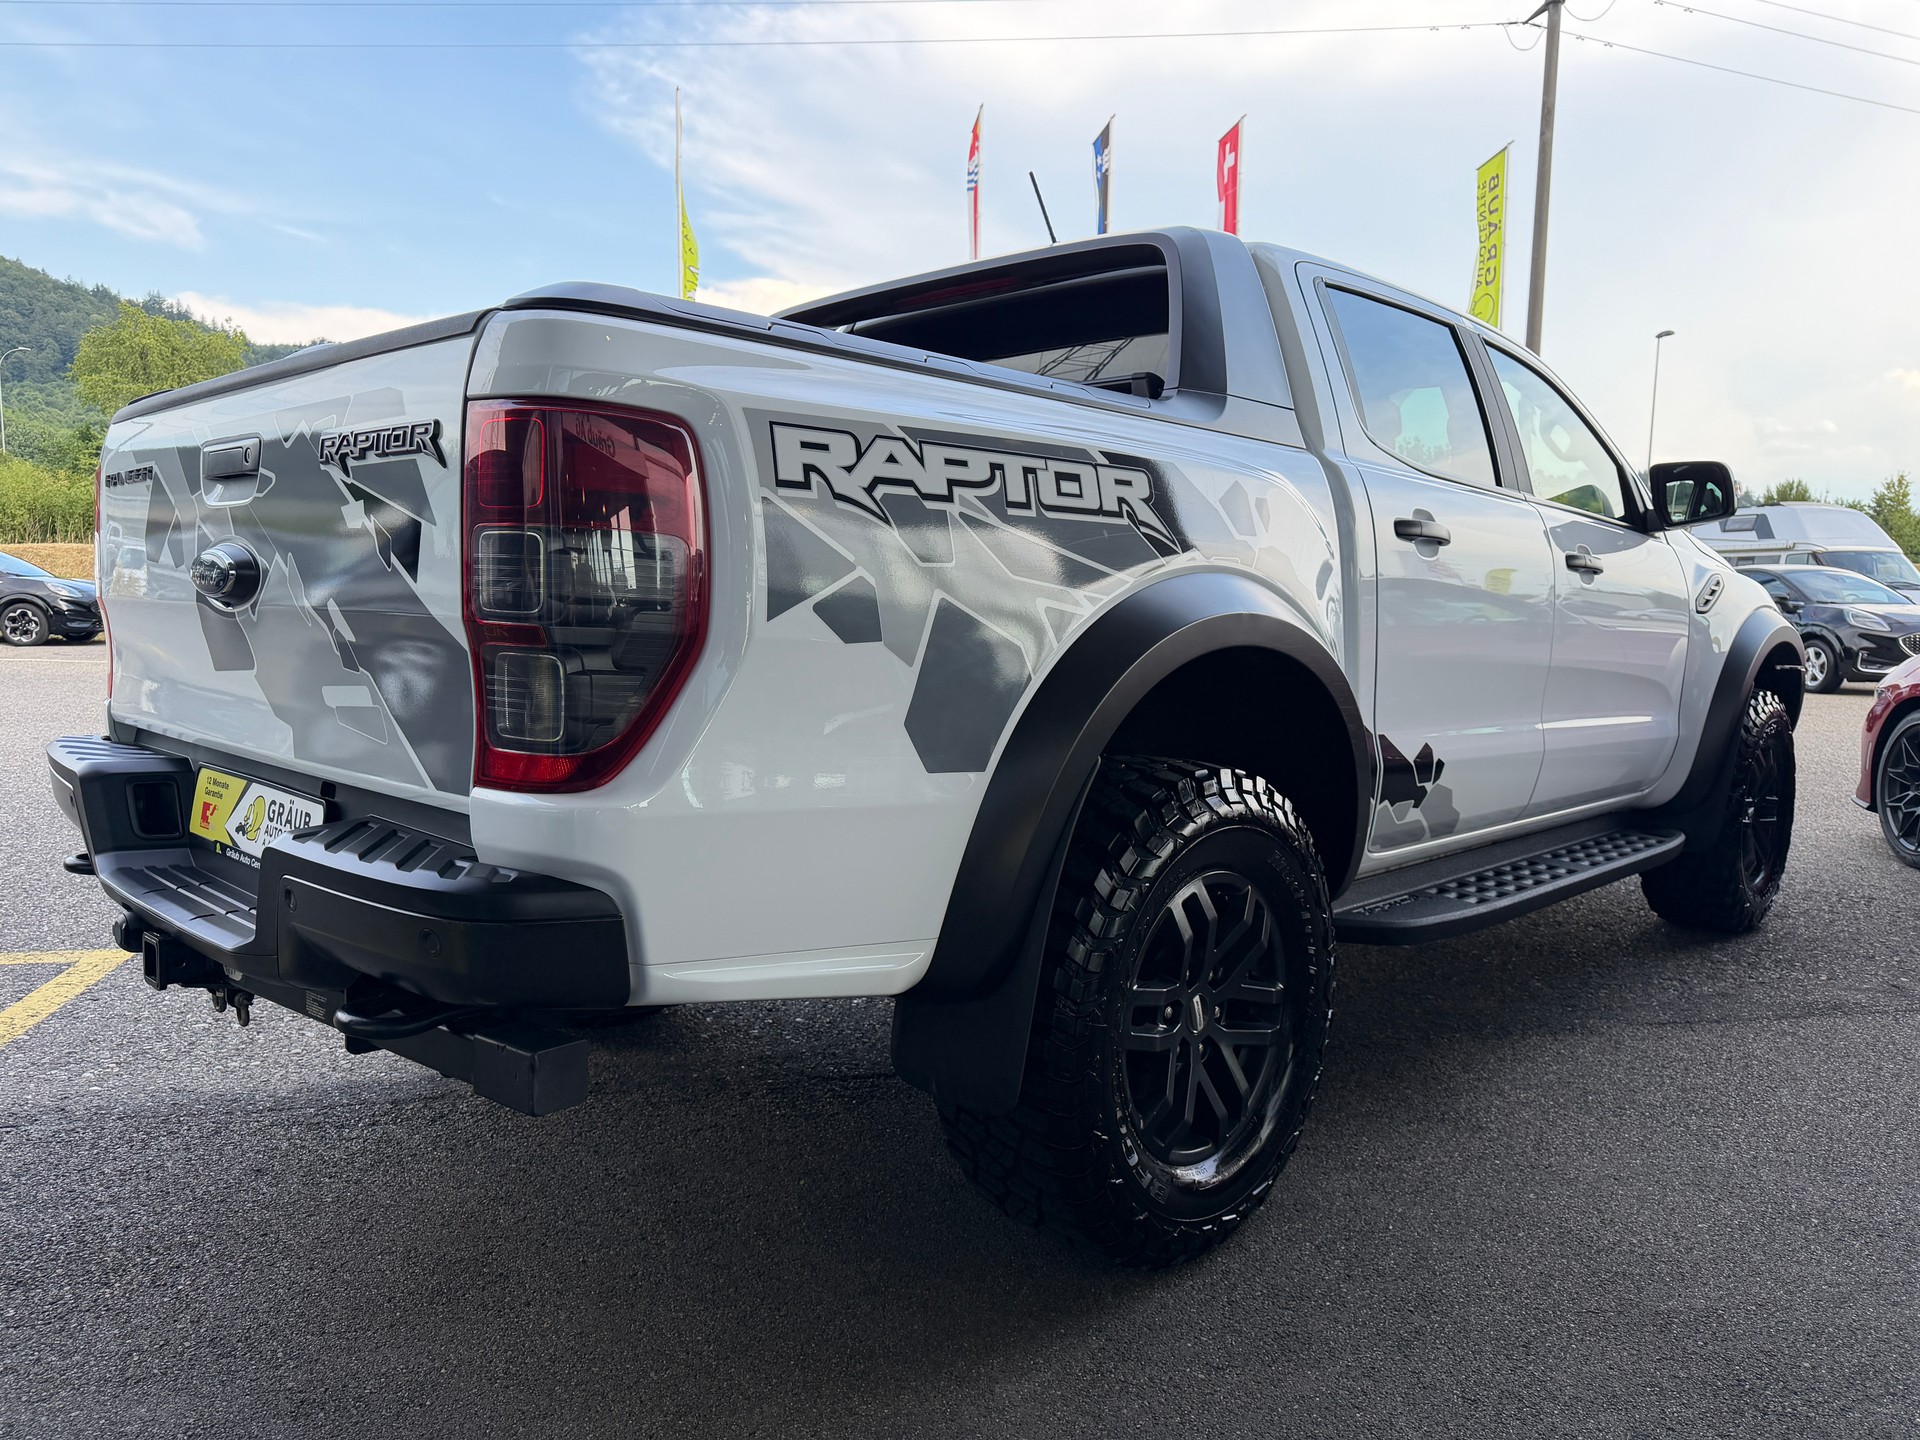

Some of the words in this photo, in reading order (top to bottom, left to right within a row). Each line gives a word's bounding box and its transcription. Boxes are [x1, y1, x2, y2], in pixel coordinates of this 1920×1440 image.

[319, 419, 447, 479] RAPTOR
[769, 421, 1181, 554] RAPTOR
[212, 777, 230, 790] Monate
[204, 786, 223, 800] Garantie
[264, 823, 287, 839] AUTO
[240, 853, 251, 865] Auto
[251, 858, 262, 870] Cen
